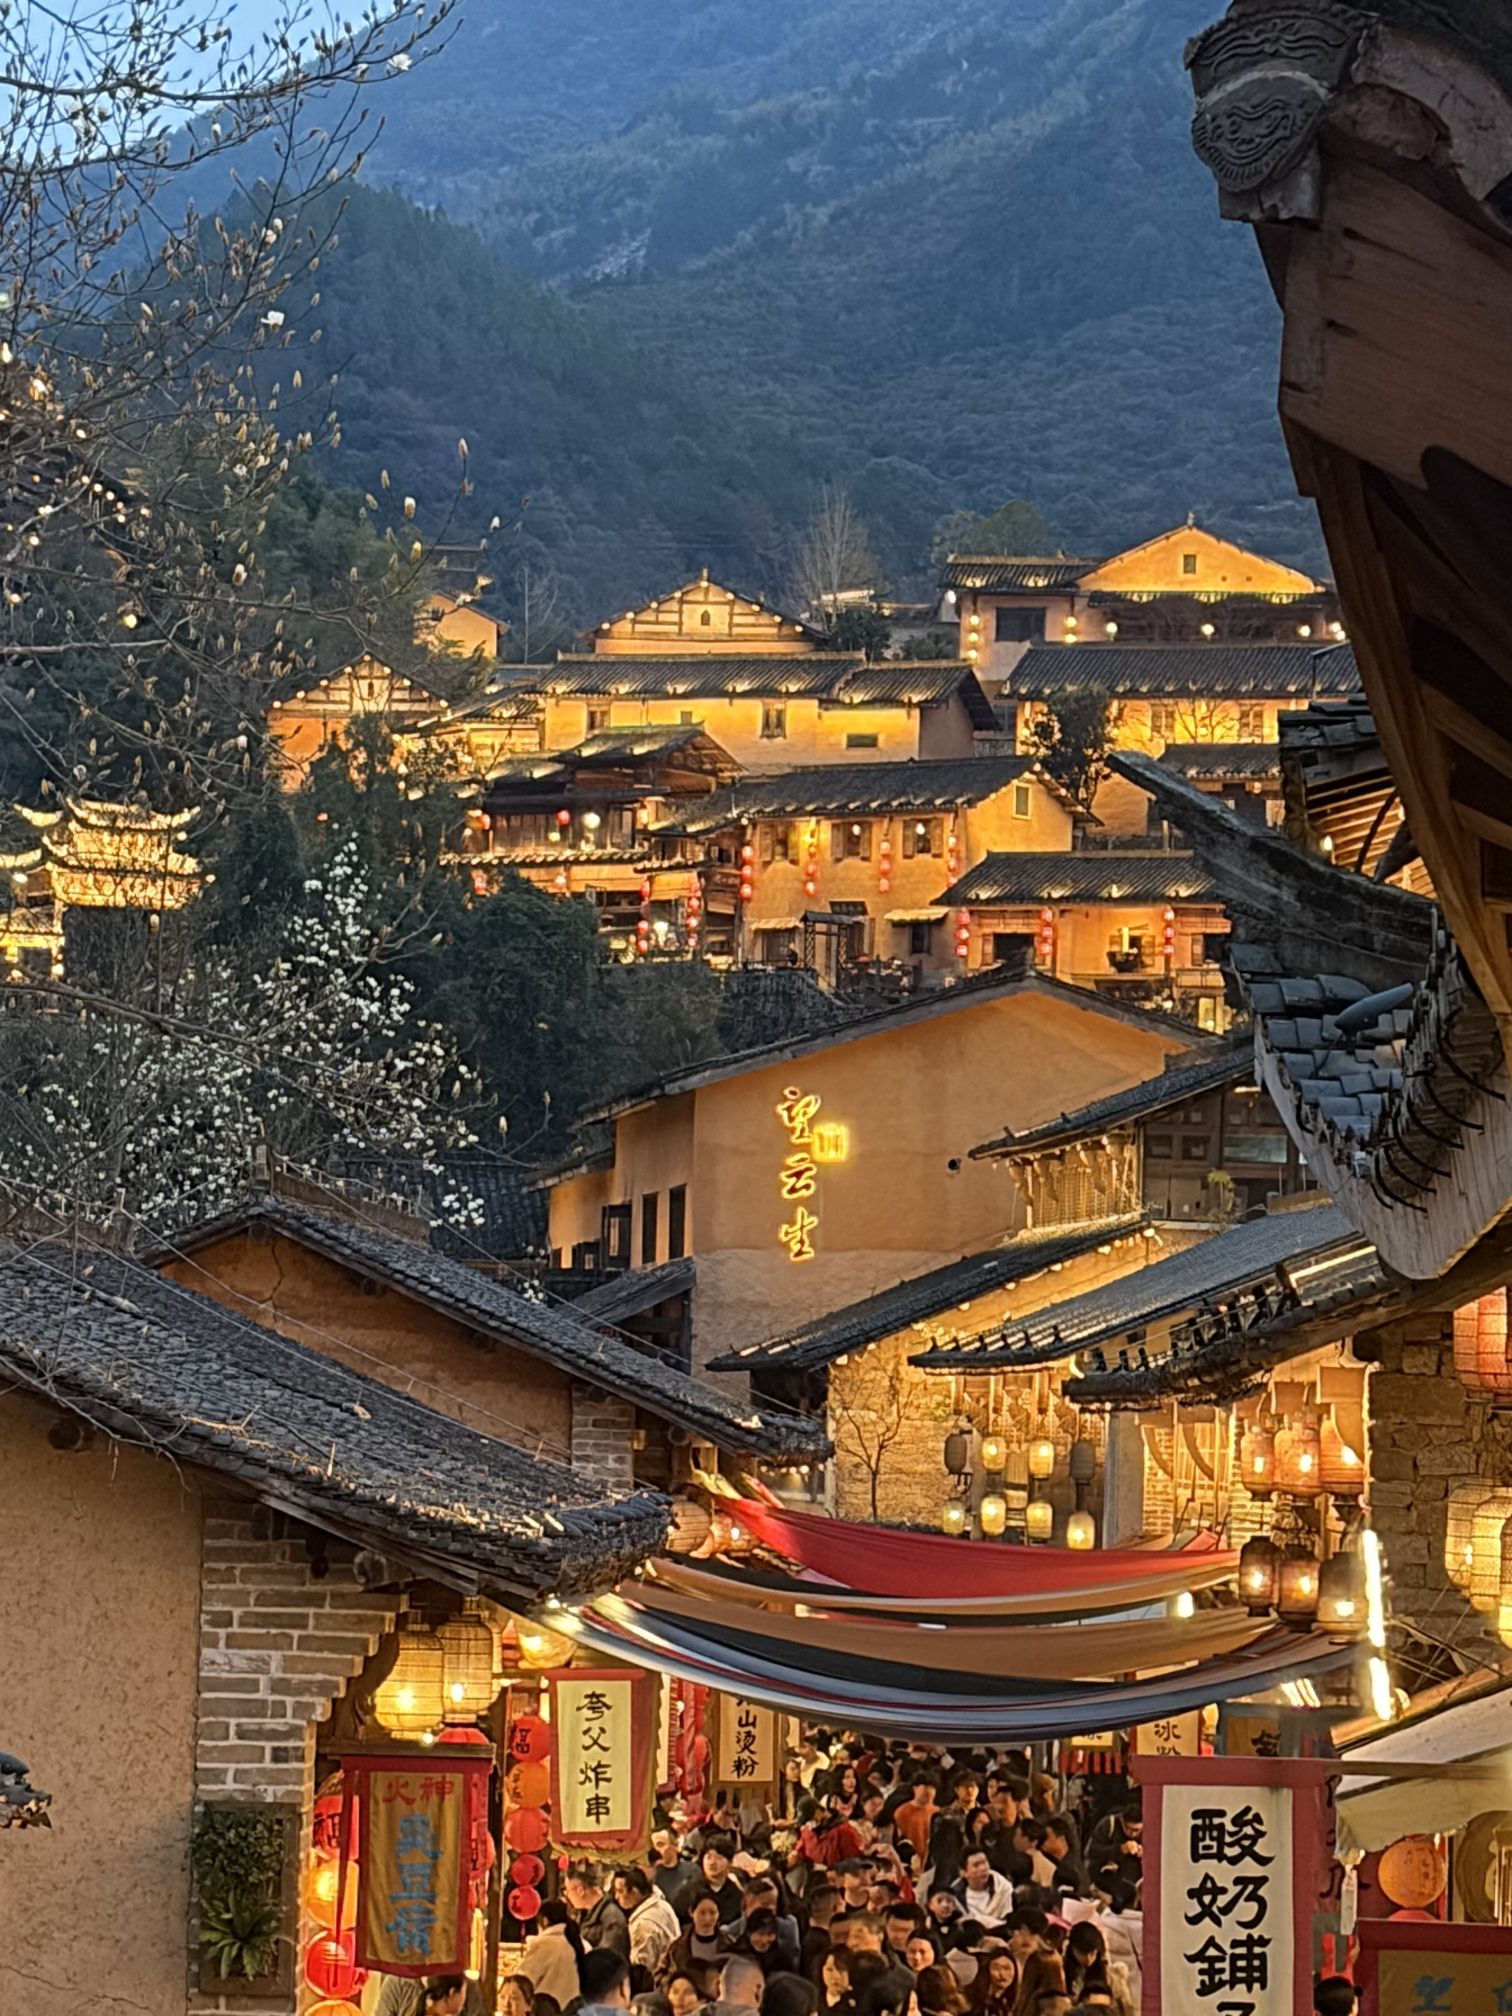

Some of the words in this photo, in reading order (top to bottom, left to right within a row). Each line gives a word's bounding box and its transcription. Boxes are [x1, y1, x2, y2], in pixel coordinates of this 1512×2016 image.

[575, 1690, 614, 1826] 夸父炸串
[731, 1699, 760, 1779] 山烫粉
[1183, 1805, 1277, 2016] 酸奶鋪
